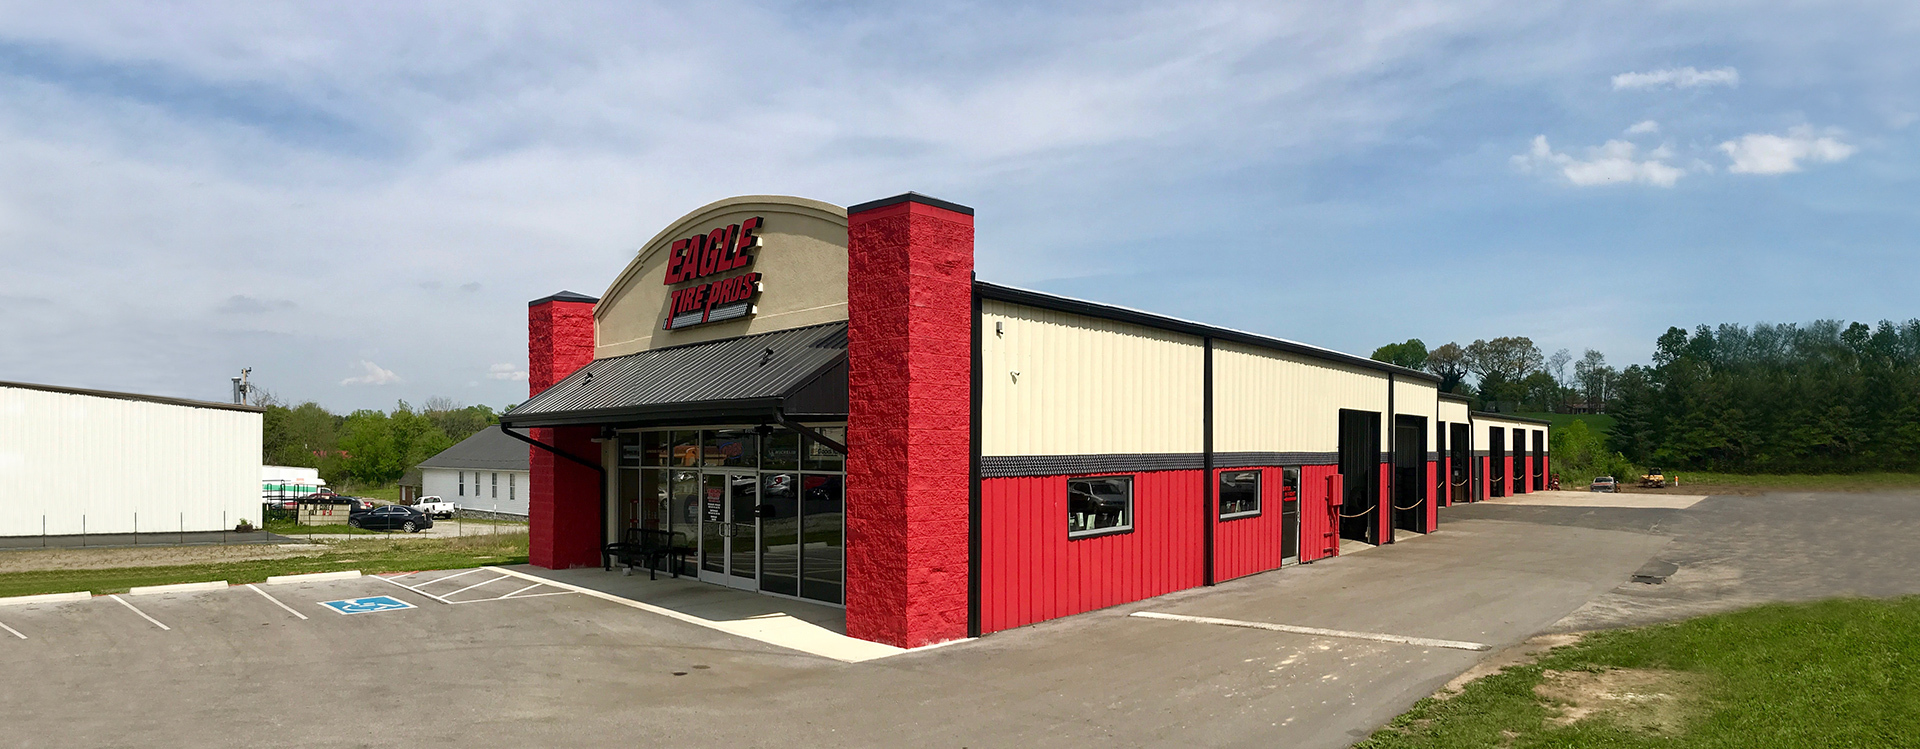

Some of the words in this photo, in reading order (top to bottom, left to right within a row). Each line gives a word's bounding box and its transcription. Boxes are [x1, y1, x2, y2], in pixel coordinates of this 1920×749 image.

[664, 216, 762, 285] EAGLE
[665, 284, 711, 329] TIRE
[702, 272, 760, 323] PROS
